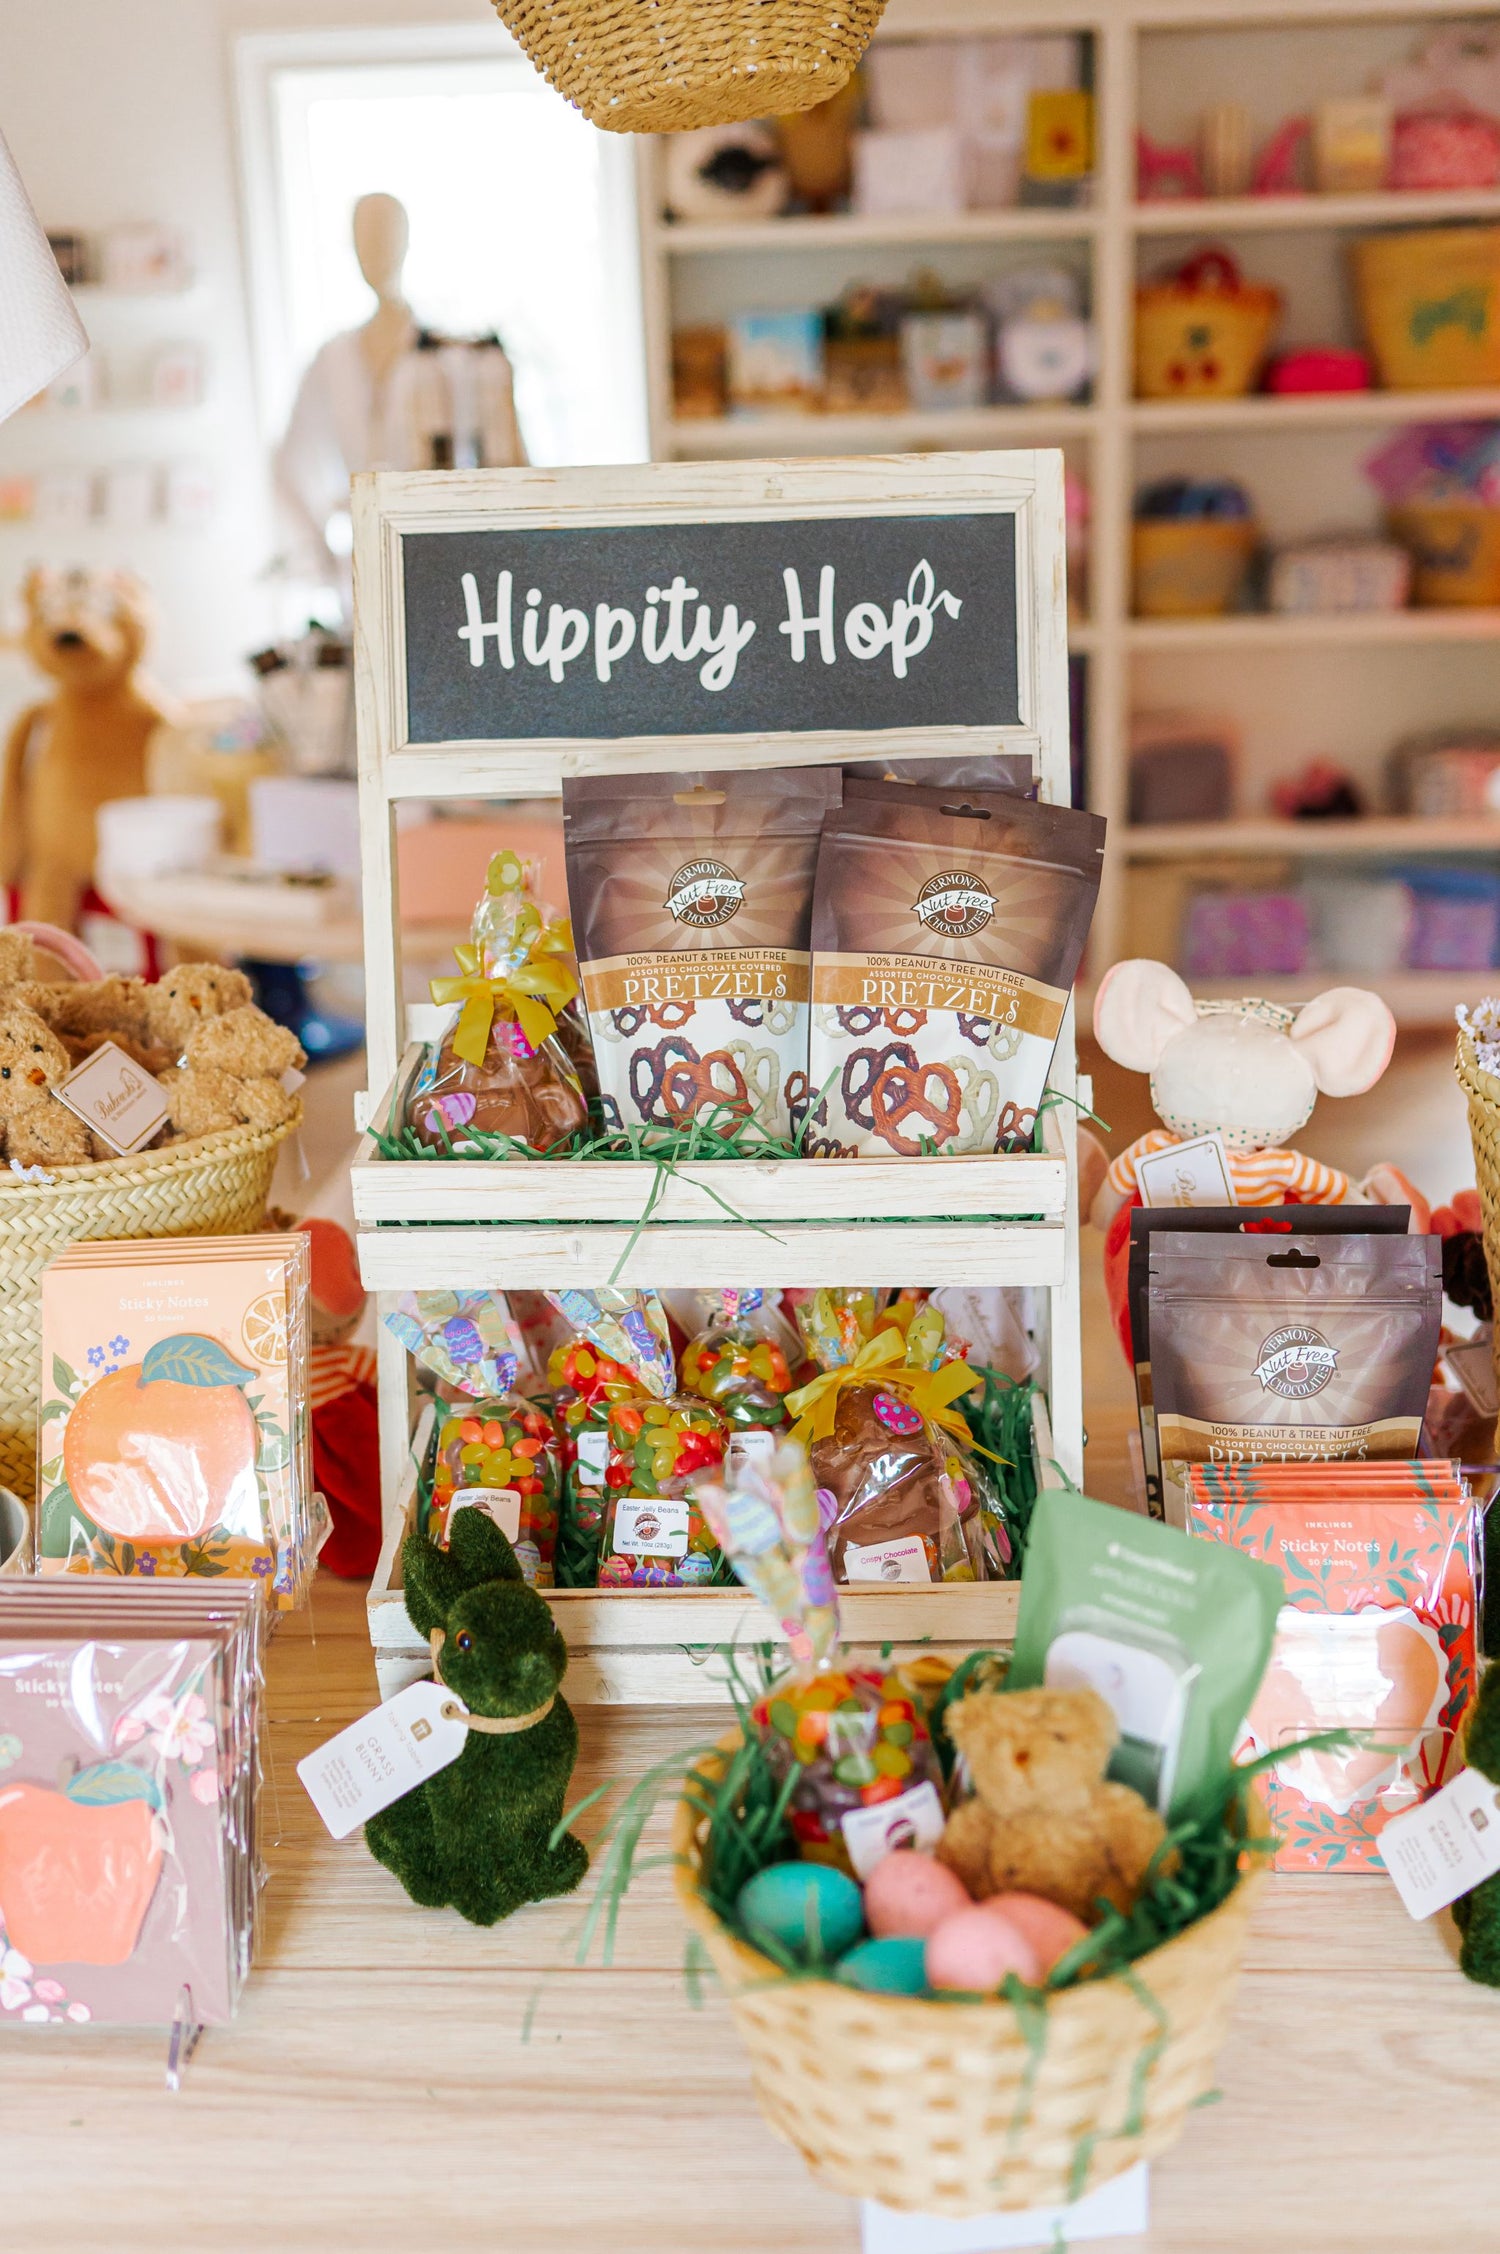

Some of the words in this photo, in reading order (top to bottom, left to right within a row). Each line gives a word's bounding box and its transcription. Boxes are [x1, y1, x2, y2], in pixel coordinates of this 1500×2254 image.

[458, 570, 756, 691] Hippity
[778, 565, 936, 678] Hop
[674, 863, 725, 888] VERMONT
[926, 874, 979, 895] VERMONT
[673, 884, 701, 912] Nut
[705, 880, 738, 895] Free
[921, 893, 952, 916] Nut
[956, 891, 990, 908] Free
[681, 897, 737, 924] CHOCOLATES
[928, 909, 987, 935] CHOCOLATES
[626, 955, 652, 966] 100%
[656, 953, 698, 964] PEANUT
[700, 952, 708, 962] &
[711, 951, 737, 961] TREE
[739, 950, 761, 960] NUT
[763, 950, 787, 961] FREE
[630, 966, 676, 977] ASSORTED
[680, 964, 737, 974] CHOCOLATE
[739, 963, 782, 972] COVERED
[866, 956, 891, 966] 100%
[895, 956, 937, 971] PEANUT
[939, 961, 947, 970] &
[951, 963, 975, 976] TREE
[978, 968, 1001, 980] NUT
[1002, 973, 1026, 988] FREE
[869, 970, 913, 979] ASSORTED
[916, 972, 974, 987] CHOCOLATE
[977, 980, 1018, 997] COVERED
[623, 972, 787, 1004] PRETZELS
[860, 979, 1020, 1024] PRETZELS
[119, 1296, 164, 1311] Sticky
[167, 1295, 209, 1309] Notes
[1264, 1329, 1318, 1355] VERMONT
[1262, 1351, 1292, 1380] Nut
[1295, 1347, 1331, 1362] Free
[1270, 1364, 1329, 1396] CHOCOLATES
[1211, 1425, 1238, 1437] 100%
[1242, 1427, 1286, 1439] PEANUT
[1288, 1430, 1296, 1439] &
[1299, 1429, 1326, 1440] TREE
[1329, 1430, 1350, 1440] NUT
[1351, 1425, 1373, 1438] FREE
[1214, 1439, 1262, 1449] ASSORTED
[1266, 1441, 1326, 1451] CHOCOLATE
[1329, 1438, 1365, 1451] COVERED
[490, 1494, 511, 1503] Beans
[622, 1504, 640, 1512] Easter
[641, 1505, 656, 1513] Jelly
[657, 1506, 679, 1514] Beans
[1305, 1521, 1353, 1529] INKLINGS
[860, 1555, 882, 1565] Crispy
[883, 1547, 918, 1560] Chocolate
[1279, 1539, 1329, 1555] Sticky
[1334, 1539, 1380, 1553] Notes
[1308, 1558, 1320, 1567] 50
[1322, 1558, 1353, 1567] Sheets
[15, 1678, 67, 1696] Sticky
[355, 1743, 385, 1784] BUNNY
[367, 1736, 395, 1777] GRASS
